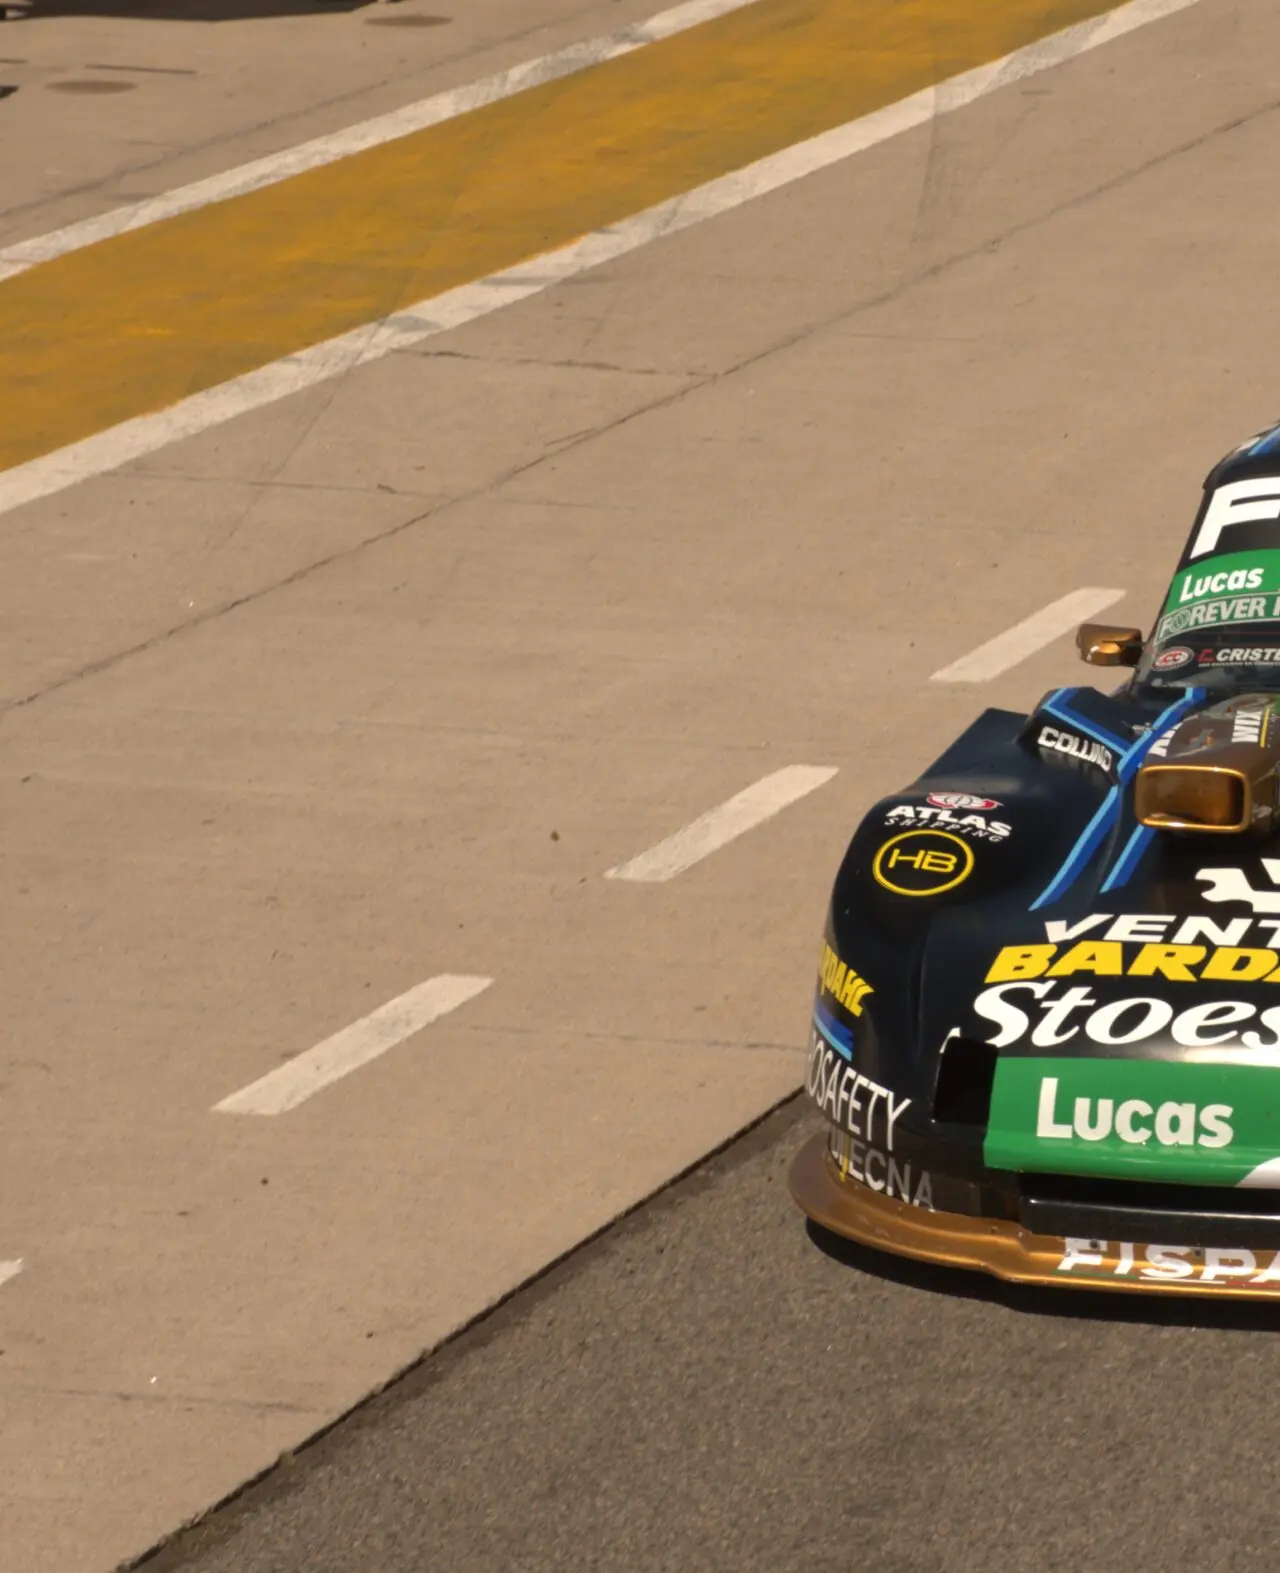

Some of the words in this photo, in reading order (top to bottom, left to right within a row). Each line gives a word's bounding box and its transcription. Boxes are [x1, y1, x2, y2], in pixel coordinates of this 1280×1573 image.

[1179, 568, 1264, 603] Lucas
[1159, 595, 1267, 639] FOREVER
[1037, 726, 1113, 772] COLLINO
[884, 816, 1004, 843] SHIPPING
[886, 804, 1012, 838] ATLAS
[888, 848, 957, 873] HB
[1036, 1077, 1234, 1148] Lucas
